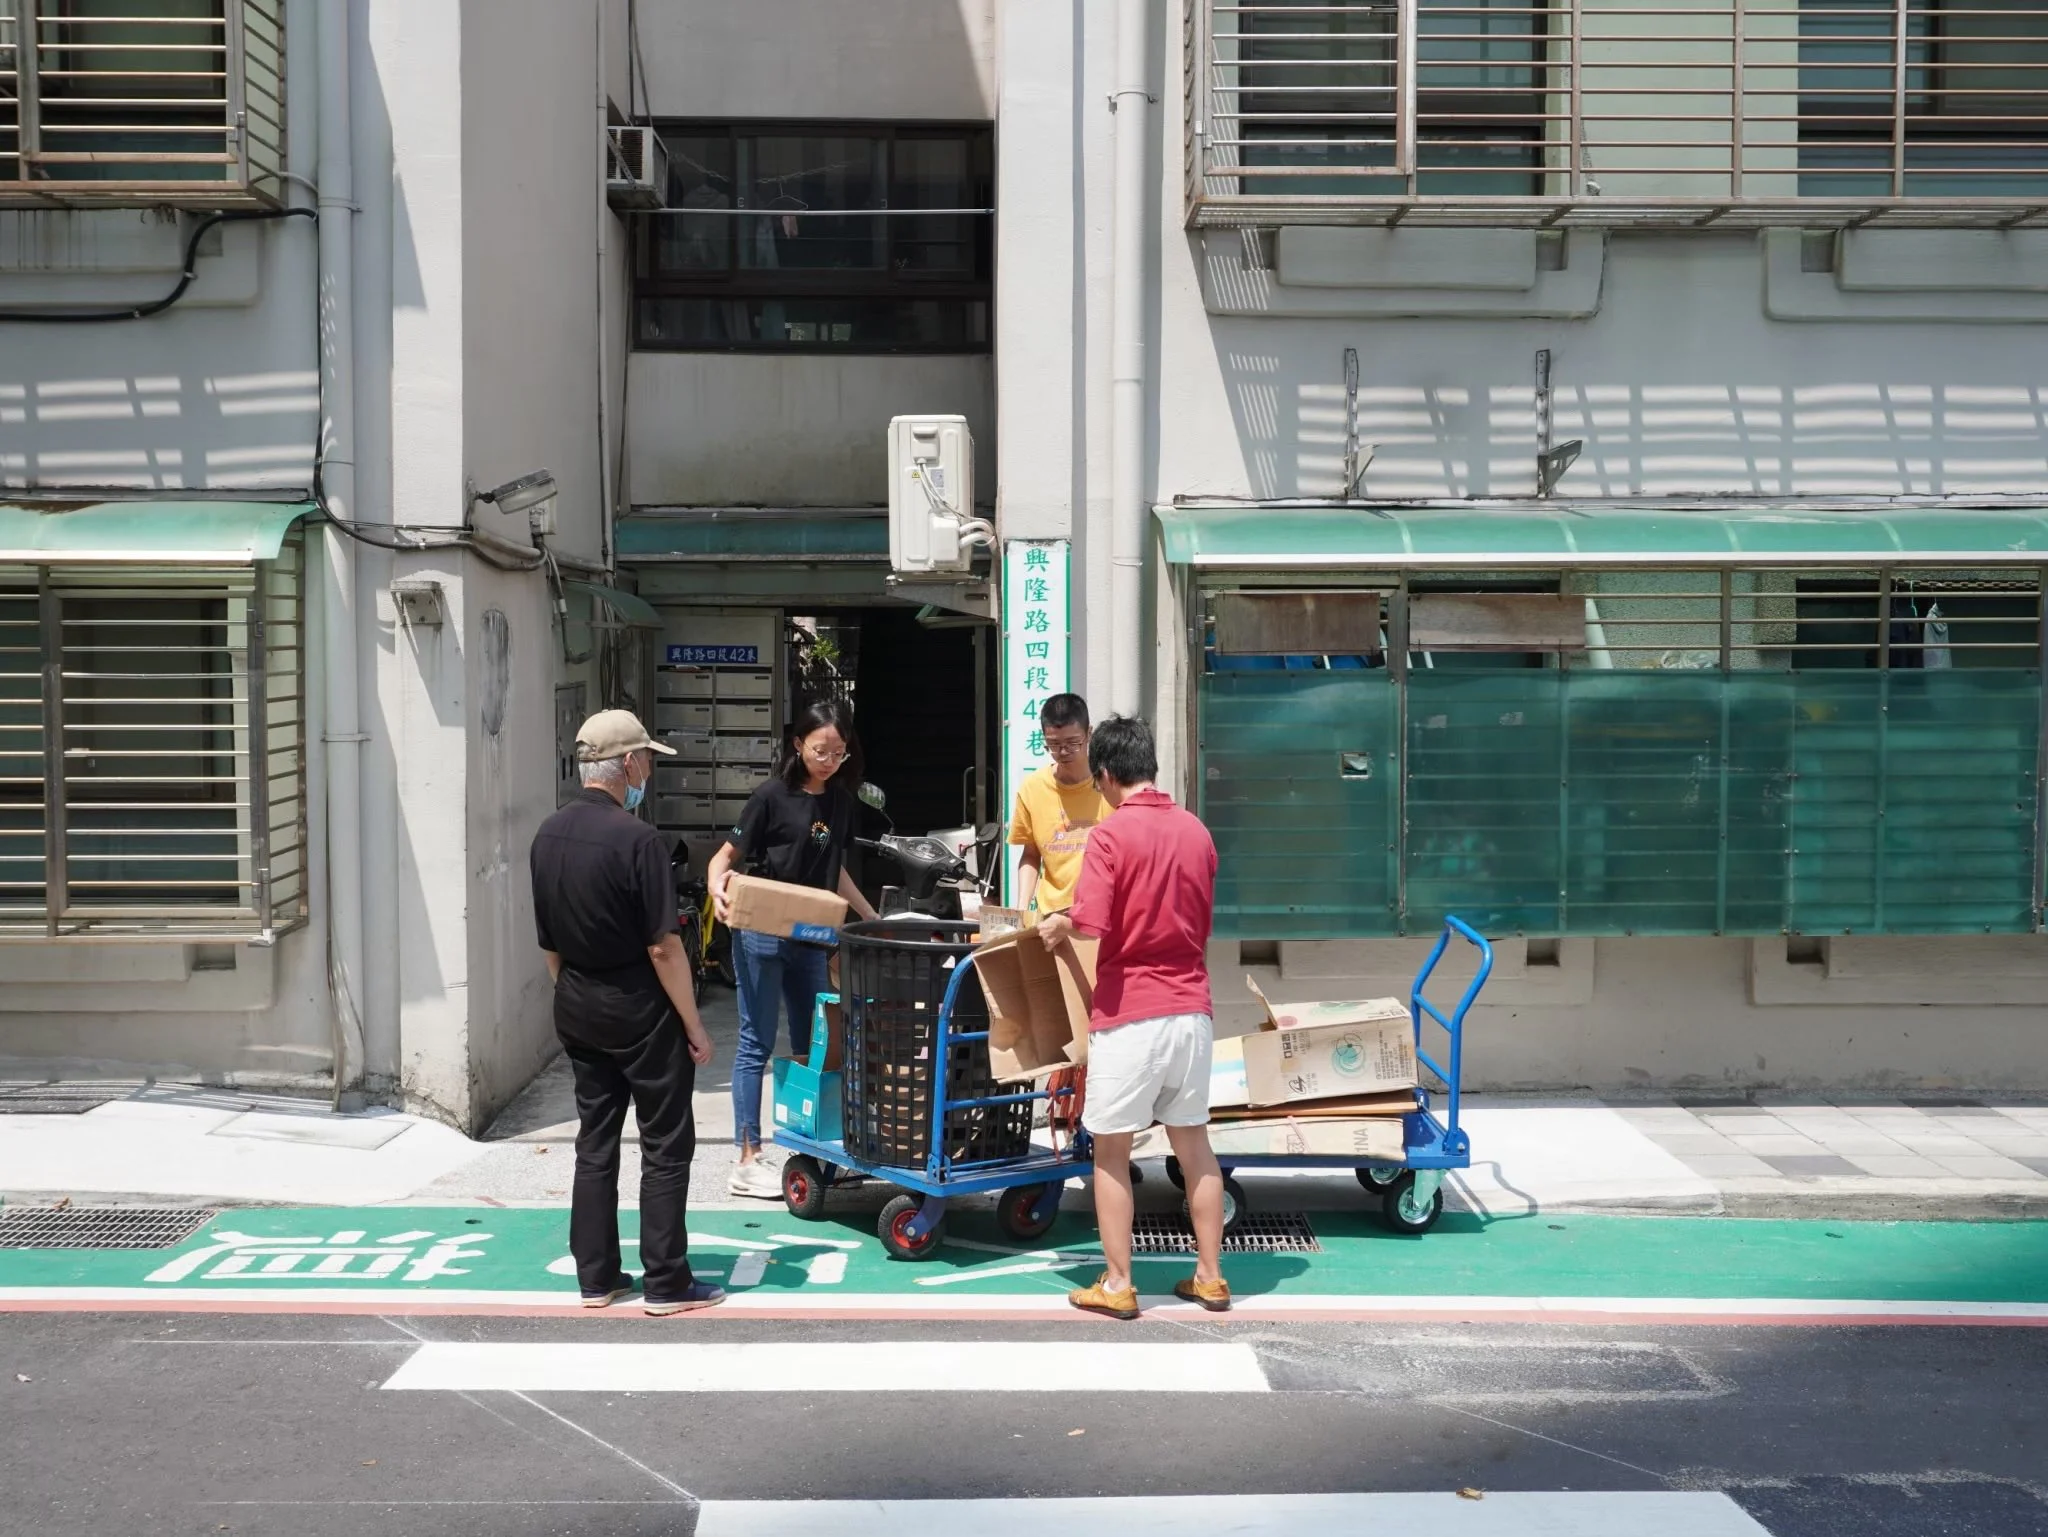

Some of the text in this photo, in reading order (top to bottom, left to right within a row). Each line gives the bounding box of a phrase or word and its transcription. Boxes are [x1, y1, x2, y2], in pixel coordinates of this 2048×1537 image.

[672, 647, 757, 662] 興隆路四段42巷
[1022, 547, 1051, 771] 興隆路四段4巷
